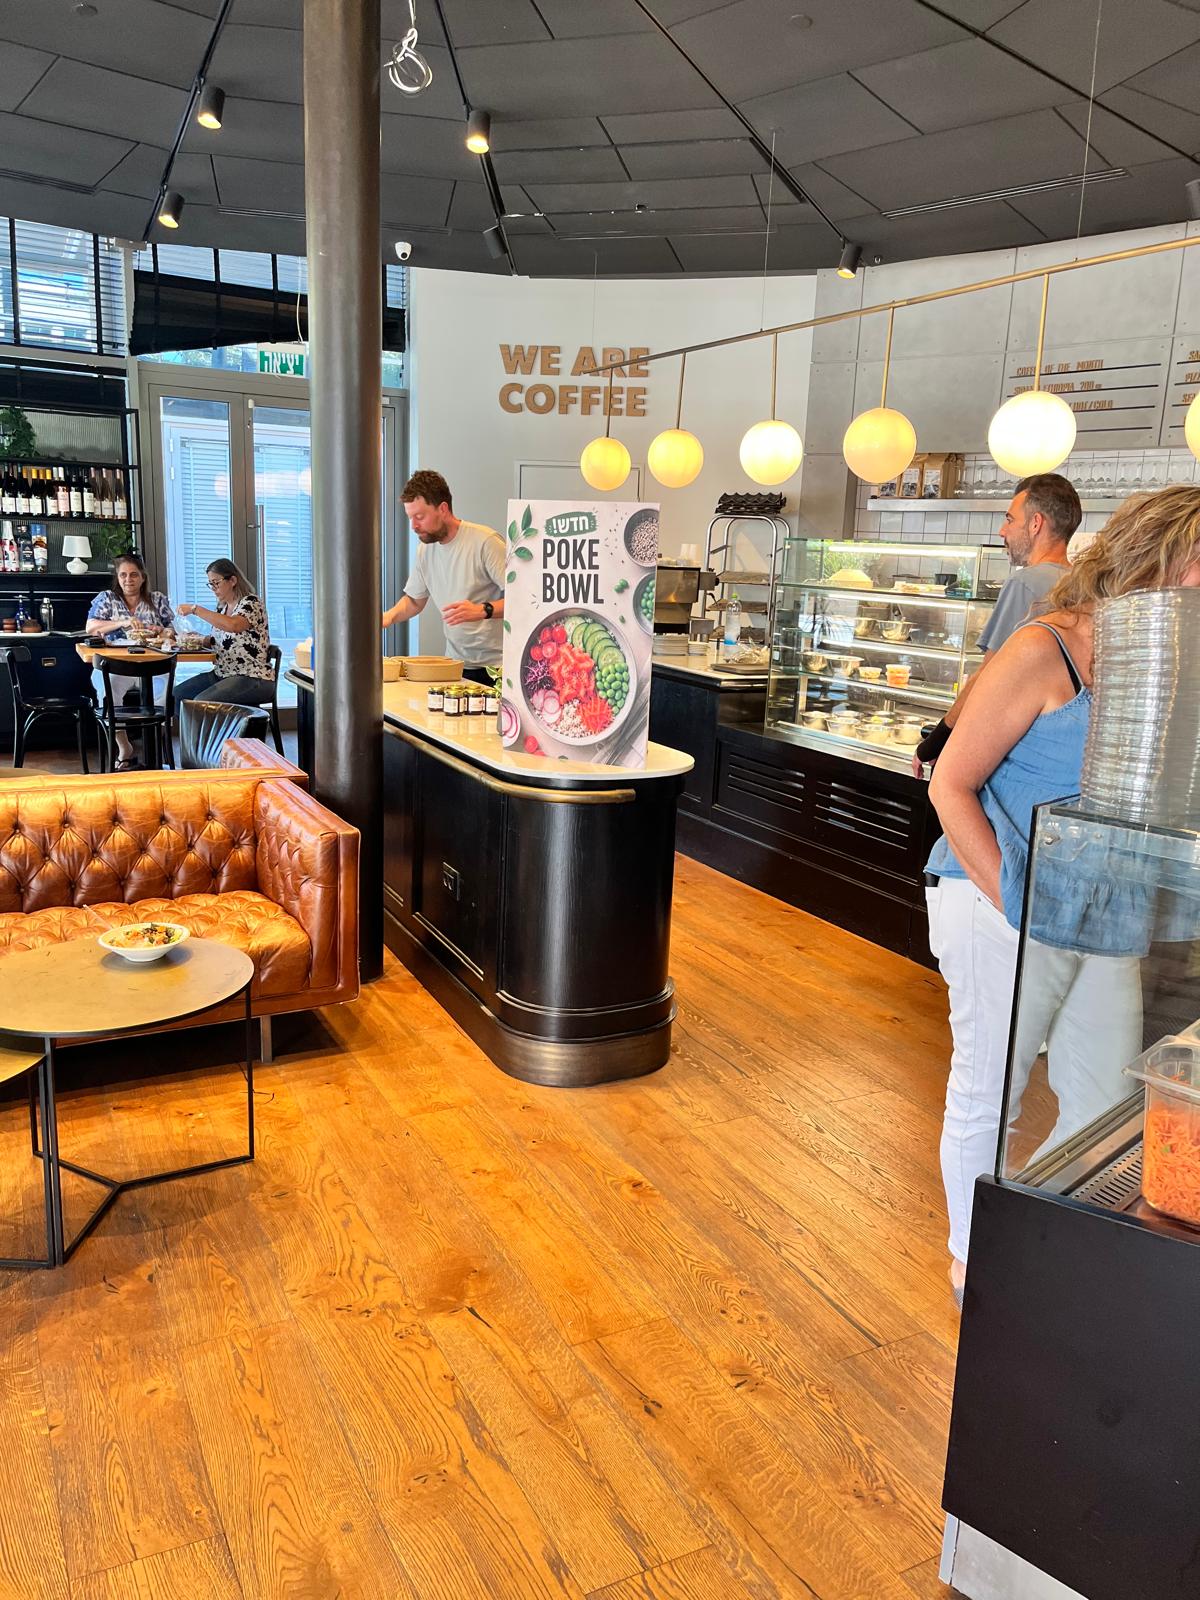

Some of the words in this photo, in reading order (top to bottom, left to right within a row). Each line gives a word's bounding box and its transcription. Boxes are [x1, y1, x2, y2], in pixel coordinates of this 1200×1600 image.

[264, 352, 300, 375] יציאה
[499, 344, 561, 376] WE
[570, 346, 649, 378] ARE
[1076, 359, 1104, 371] MONTH
[498, 382, 646, 417] COFFEE
[552, 515, 590, 534] חדש!
[542, 538, 600, 570] POKE
[542, 573, 605, 604] BOWL
